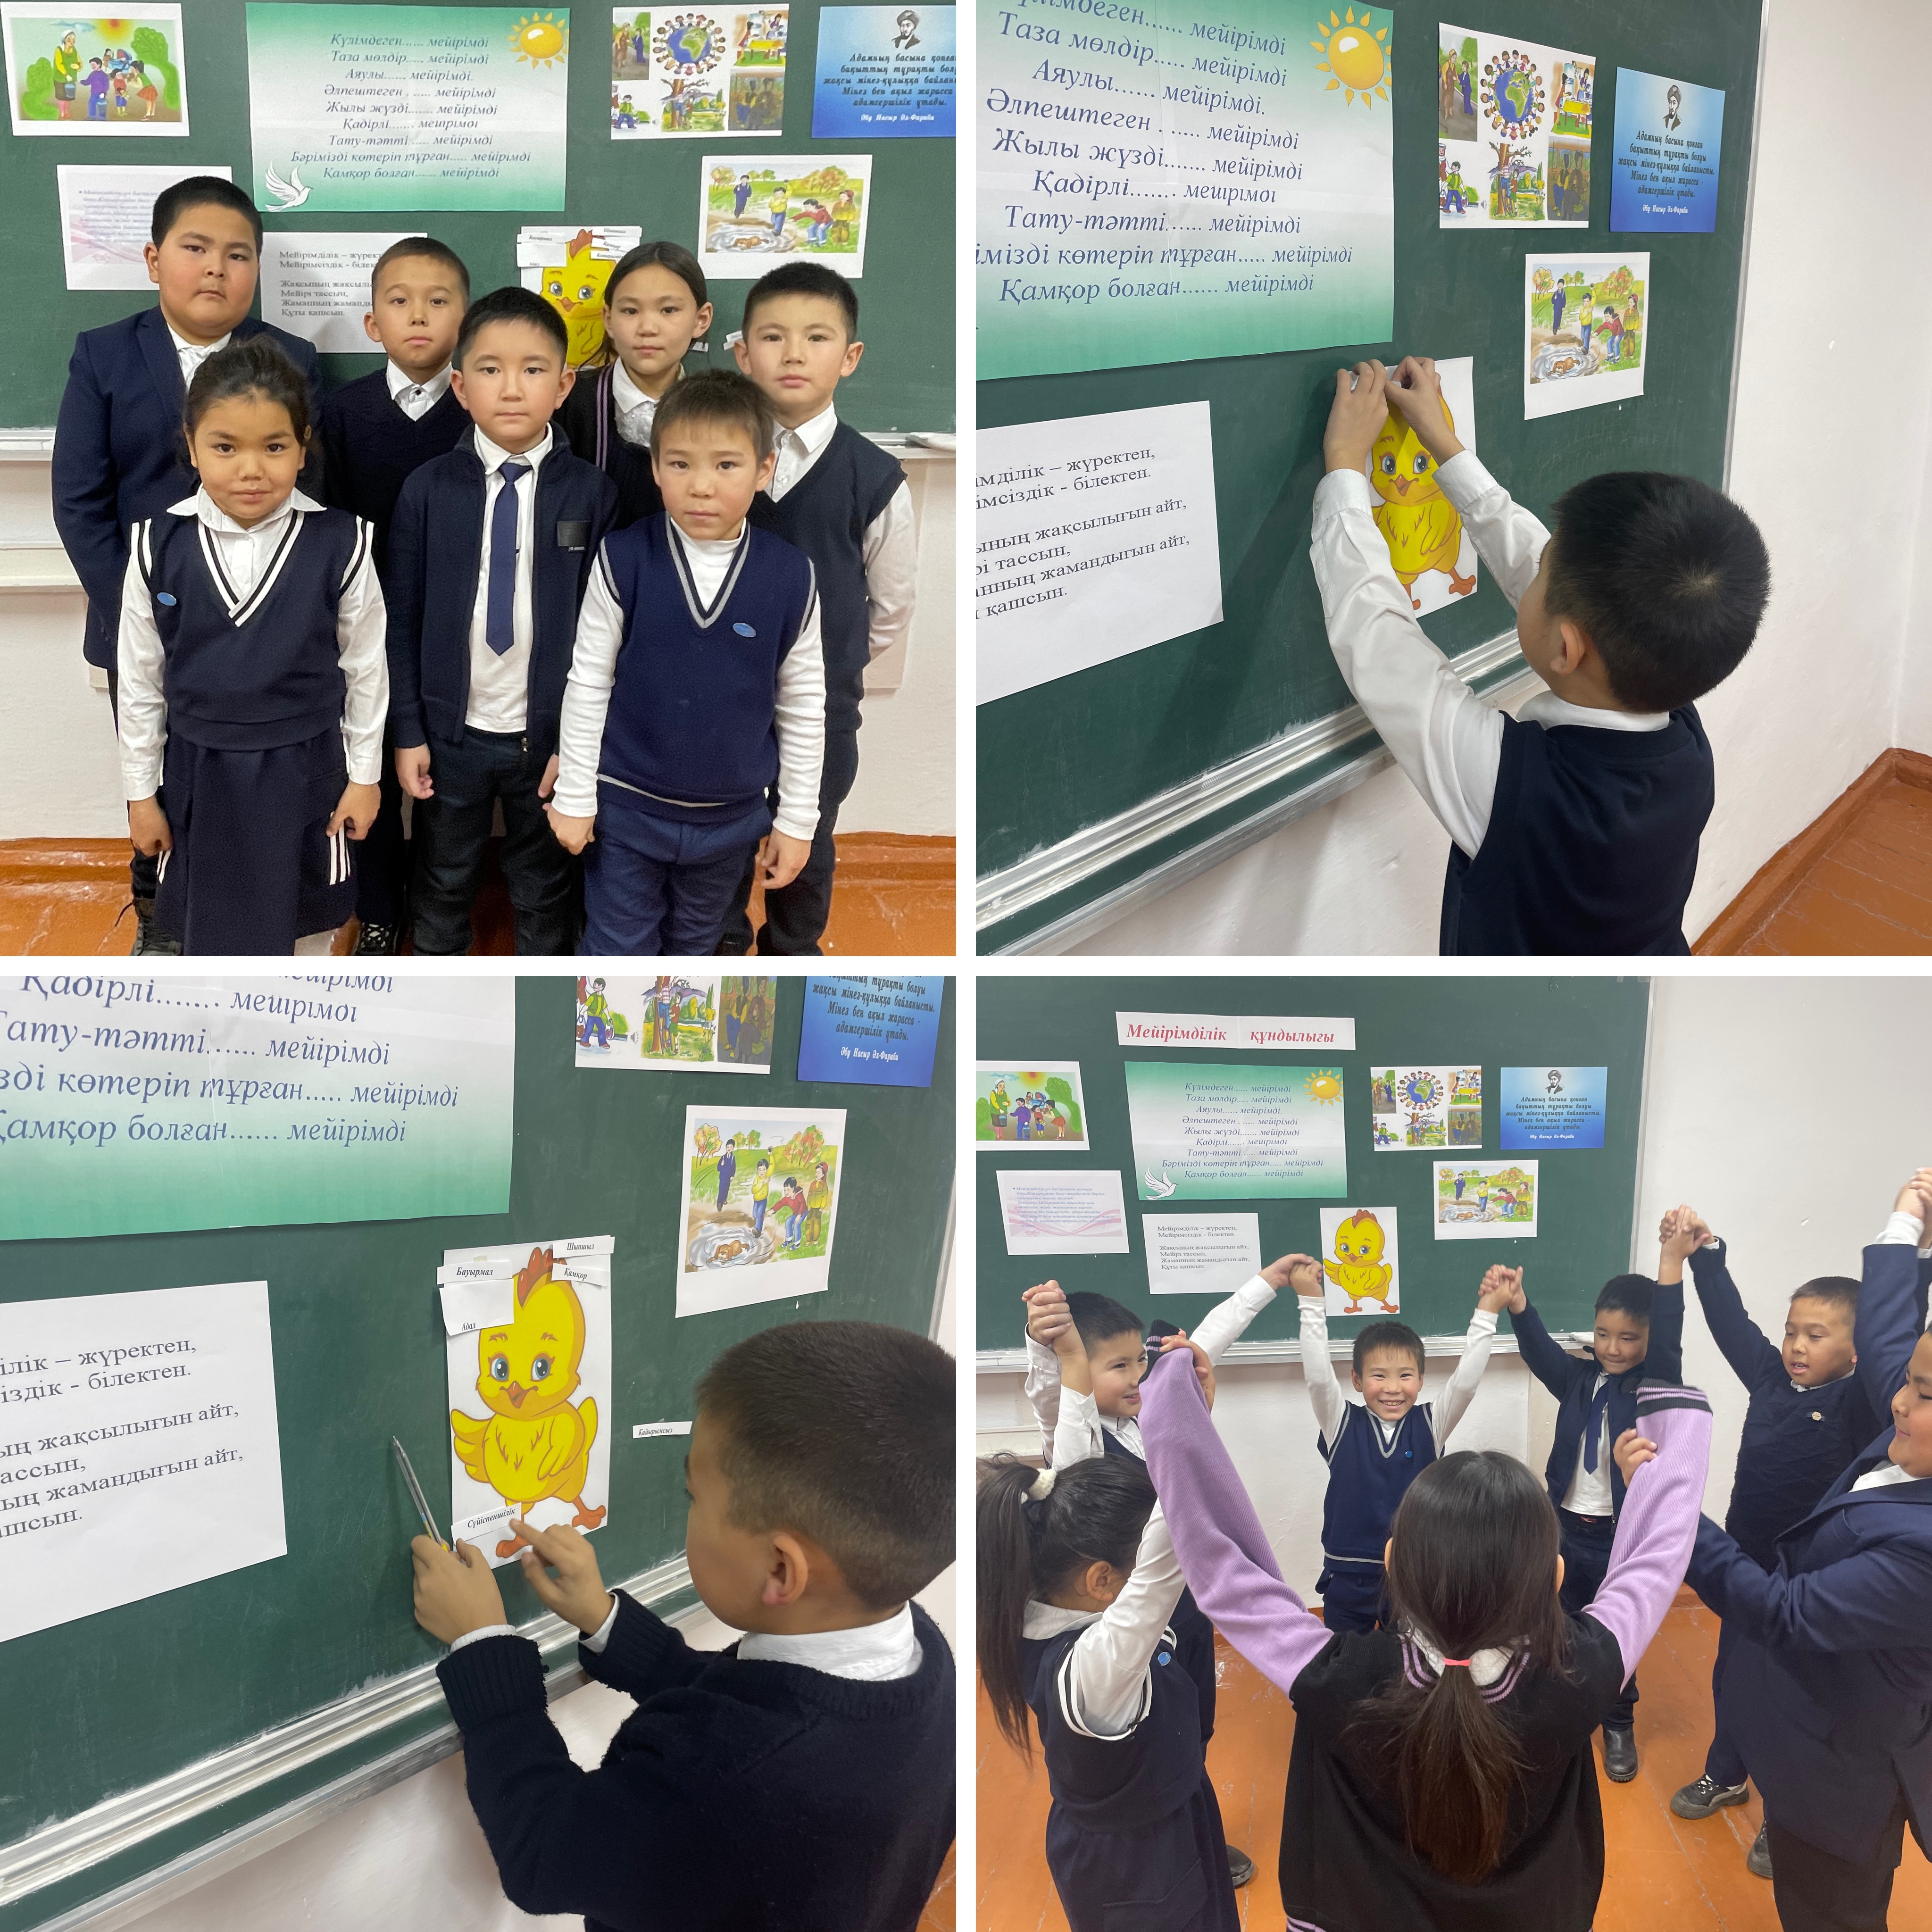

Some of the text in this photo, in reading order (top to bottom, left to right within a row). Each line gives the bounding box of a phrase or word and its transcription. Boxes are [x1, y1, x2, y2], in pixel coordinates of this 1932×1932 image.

[999, 11, 1059, 44] Таза
[1192, 56, 1286, 86] мейірімді
[1190, 23, 1285, 55] мейірімді
[1162, 85, 1264, 114] мейірімді.
[987, 88, 1299, 150] Әлпештеген мейірімді
[992, 127, 1078, 158] Жылы
[1212, 157, 1302, 181] мейірімді
[1208, 214, 1300, 237] мейірімді
[1058, 245, 1153, 269] көтеріп
[1272, 245, 1352, 266] мейірімді
[999, 279, 1099, 304] Қамқор
[1225, 274, 1314, 296] мейірімді
[1066, 449, 1154, 472] жүректен,
[1074, 469, 1150, 490] білектен.
[1035, 499, 1186, 540] жақсылығын айт,
[995, 546, 1070, 570] тассын,
[1040, 535, 1189, 580] жамандығын айт,
[985, 587, 1066, 616] қашсын.
[812, 984, 836, 998] жақсы
[894, 995, 934, 1012] байланысты.
[907, 981, 925, 997] болуы
[827, 1001, 914, 1026] Мінез бен ақыл жарасса
[836, 1020, 882, 1038] адамгершілік
[1126, 1024, 1335, 1045] Мейірімділік құндылығы
[265, 1036, 389, 1067] мейірімді
[58, 1072, 189, 1103] көтеріп
[350, 1082, 458, 1110] мейірімді
[1250, 1085, 1291, 1093] мейірімді
[1251, 1096, 1291, 1105] мейірімді
[1240, 1107, 1282, 1115] мейірімді.
[1257, 1118, 1298, 1126] мейірімді
[287, 1117, 405, 1147] мейірімді
[1259, 1129, 1299, 1137] мейірімді
[1162, 1159, 1323, 1168] Бәрімізді көтеріп мейірімді
[1258, 1149, 1298, 1157] мейірімді
[1184, 1170, 1303, 1179] Қамқор мейірімді
[567, 1242, 594, 1250] Шыншыл
[456, 1267, 493, 1278] Бауырмал
[564, 1268, 587, 1281] Қамқор
[462, 1323, 476, 1331] Адал
[78, 1340, 196, 1366] жүректен,
[88, 1365, 190, 1389] білектен.
[38, 1404, 238, 1450] жақсылығын айт,
[638, 1428, 673, 1436] Қайырымсыз
[46, 1449, 242, 1501] жамандығын айт,
[467, 1508, 516, 1529] Сүйіспеншілік
